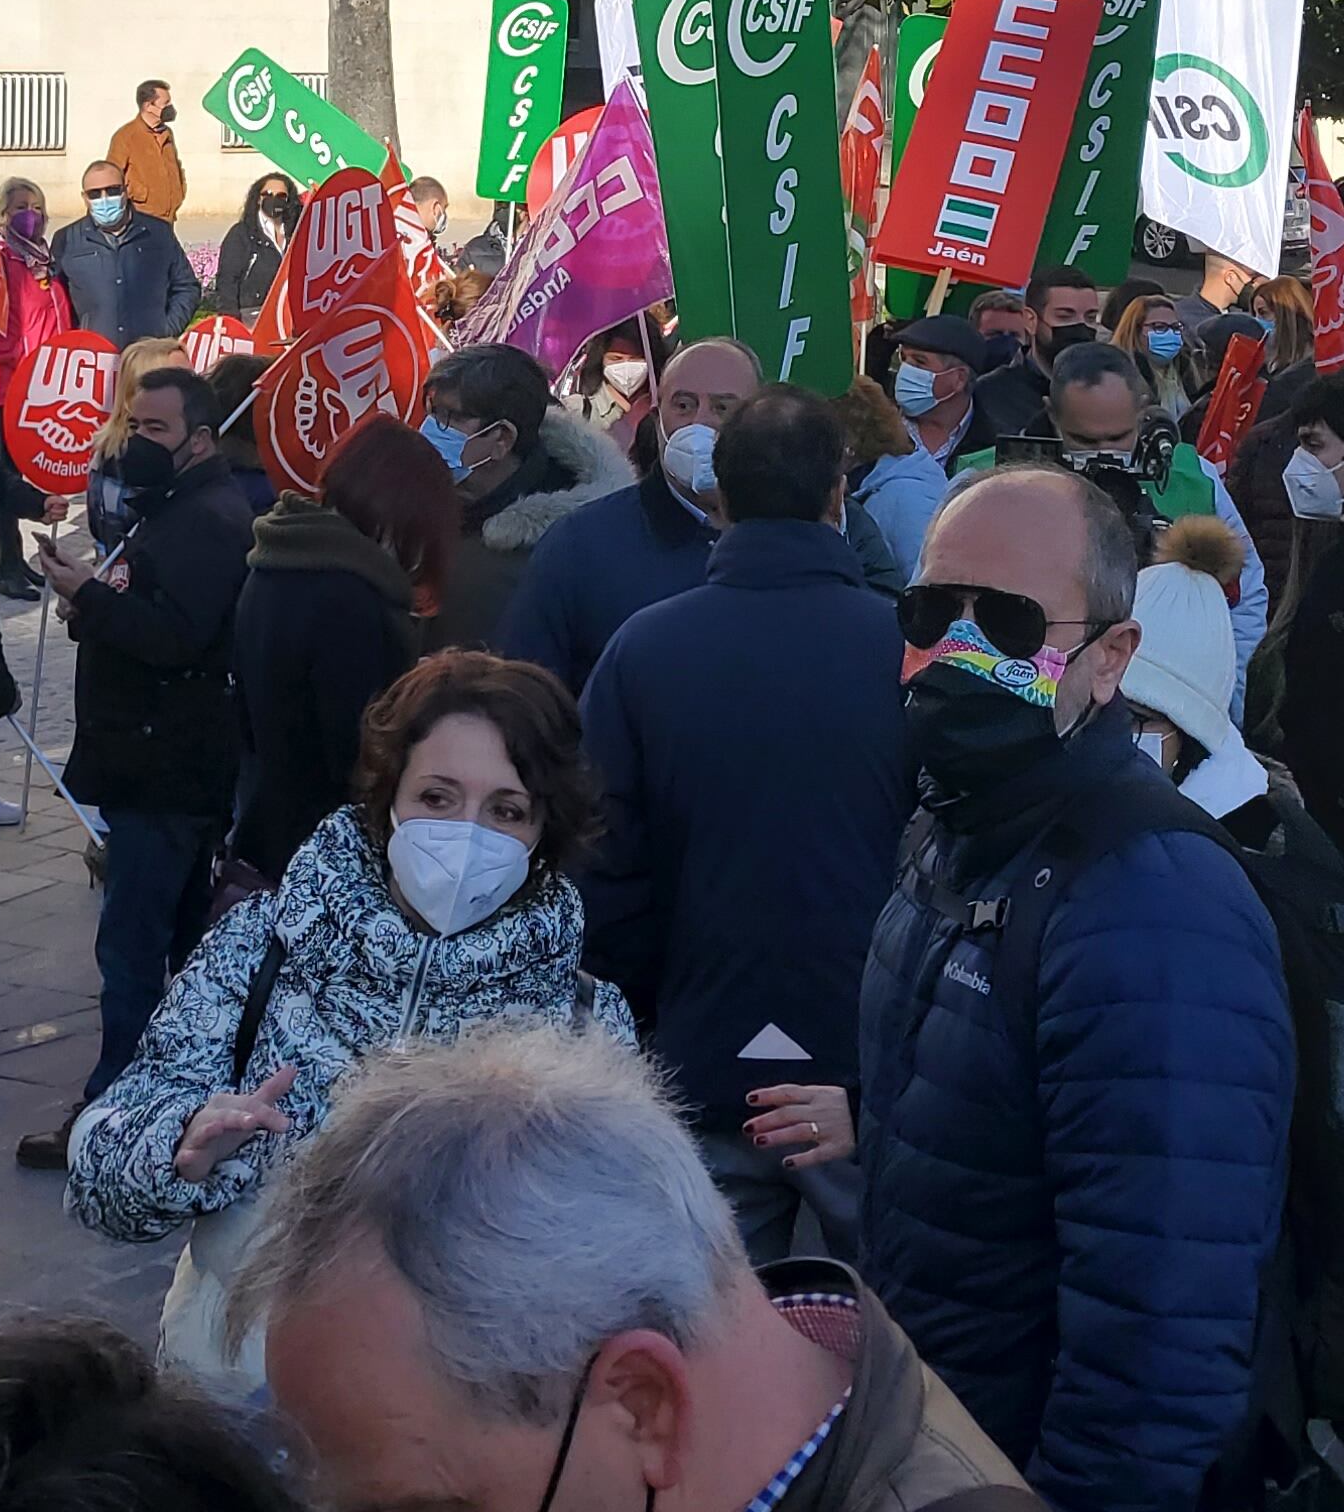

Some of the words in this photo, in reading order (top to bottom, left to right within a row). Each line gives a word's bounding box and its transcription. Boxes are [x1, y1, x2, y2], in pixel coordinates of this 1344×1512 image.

[499, 65, 539, 193] CSIF
[1064, 61, 1122, 267] CSIF
[307, 183, 383, 278] UGT
[766, 94, 811, 383] CSIF
[927, 240, 987, 267] Jaén
[28, 345, 121, 413] UGT
[32, 451, 90, 477] Andaluc
